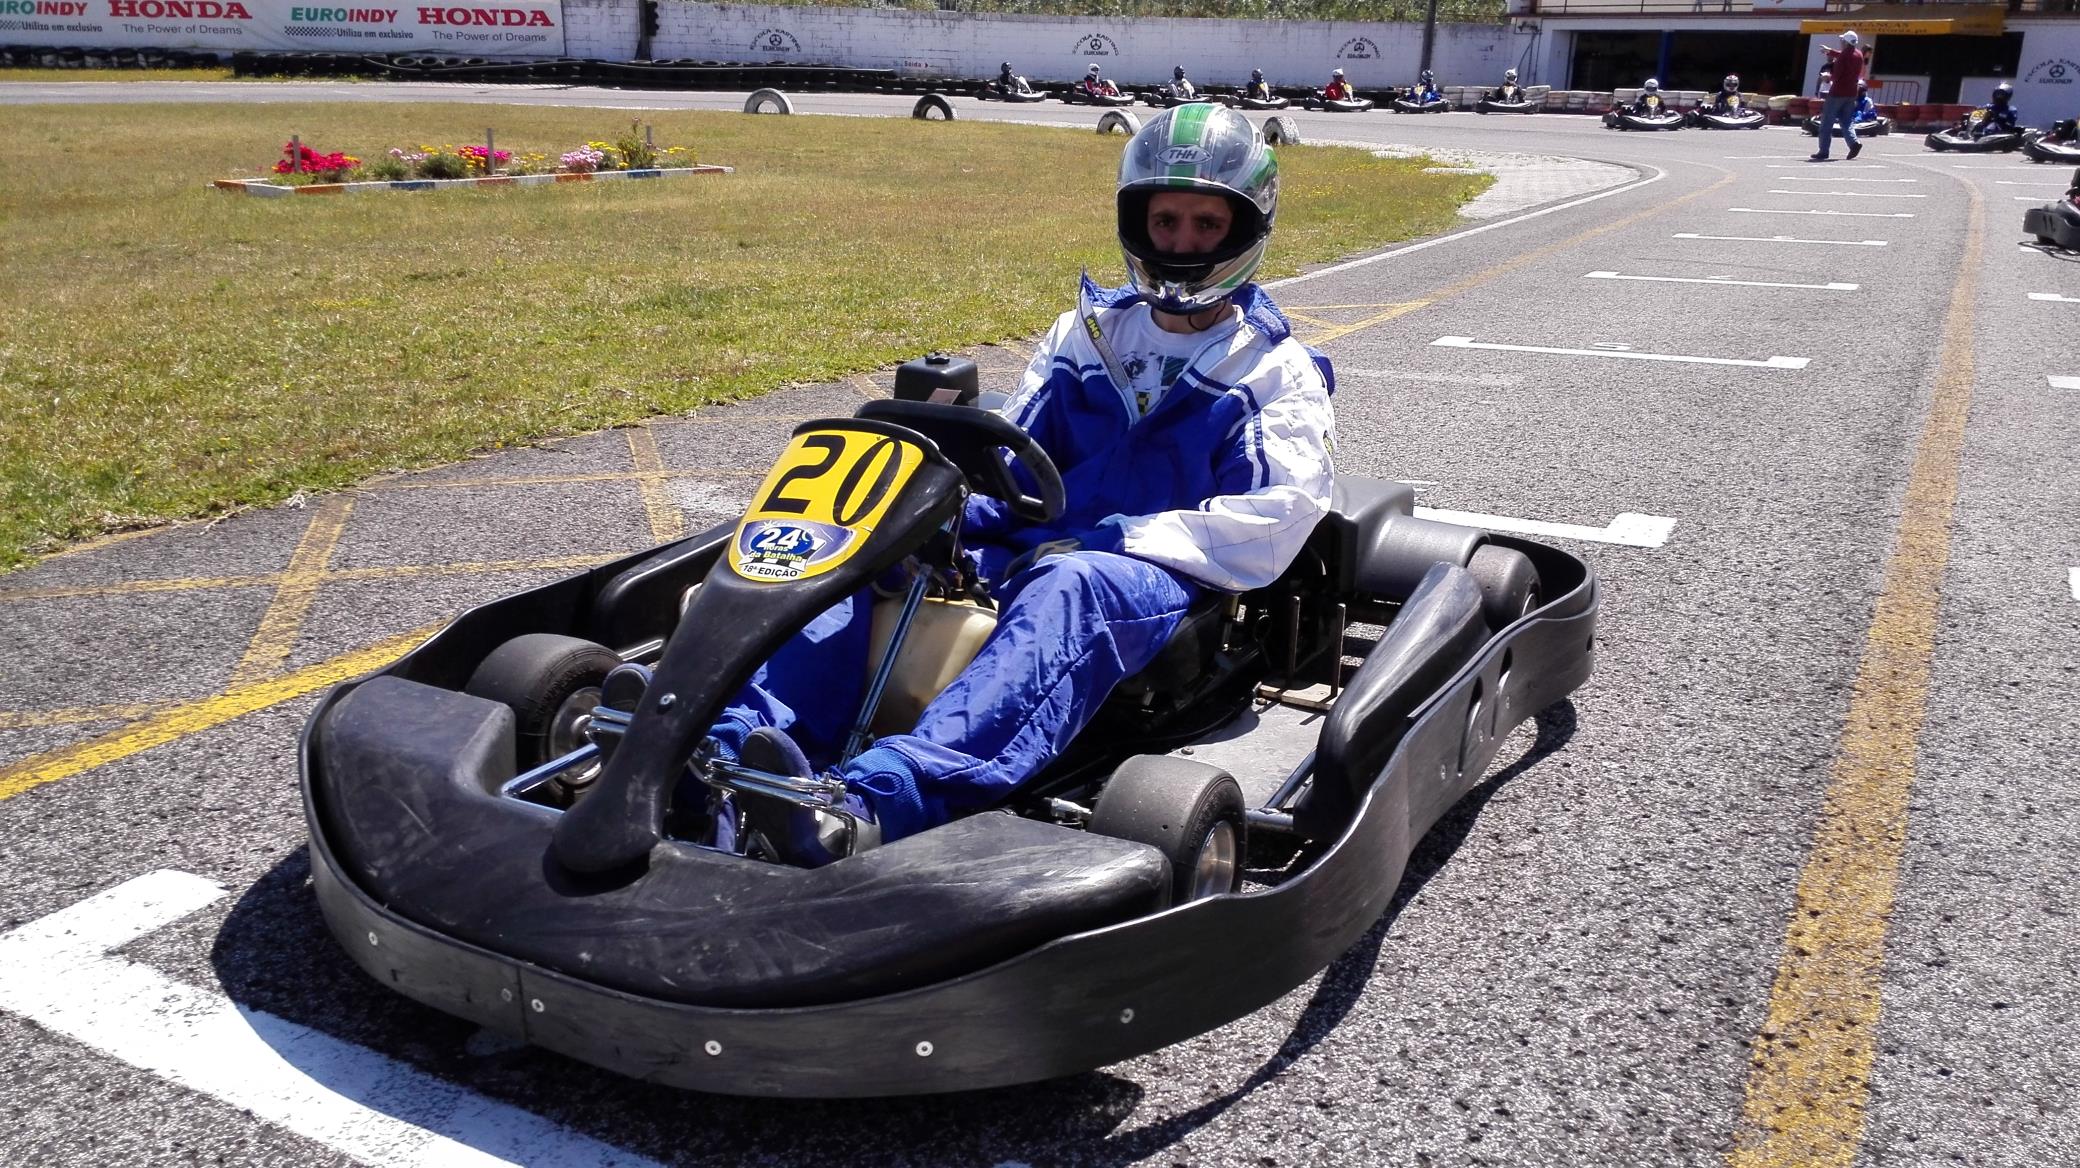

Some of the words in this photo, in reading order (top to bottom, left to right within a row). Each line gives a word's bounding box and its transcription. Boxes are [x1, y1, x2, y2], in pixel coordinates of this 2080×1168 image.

[0, 1, 88, 16] ROINDY
[108, 0, 253, 19] HONDA
[291, 7, 398, 23] EUROINDY
[417, 7, 554, 26] HONDA
[22, 21, 49, 31] Utiliza
[67, 23, 103, 32] exclusivo
[122, 24, 144, 33] The
[150, 24, 181, 34] Power
[185, 24, 196, 34] of
[199, 25, 242, 35] Dreams
[337, 28, 362, 37] Utiliza
[365, 30, 376, 38] em
[379, 29, 413, 39] exclusivo
[432, 31, 452, 40] The
[456, 31, 489, 41] Power
[493, 31, 502, 41] of
[506, 32, 547, 42] Dreams
[1169, 149, 1198, 159] THH
[759, 434, 903, 526] 20
[756, 528, 801, 549] 24
[749, 550, 762, 558] da
[763, 551, 803, 562] Batalha
[758, 566, 798, 577] EDIÇÃO
